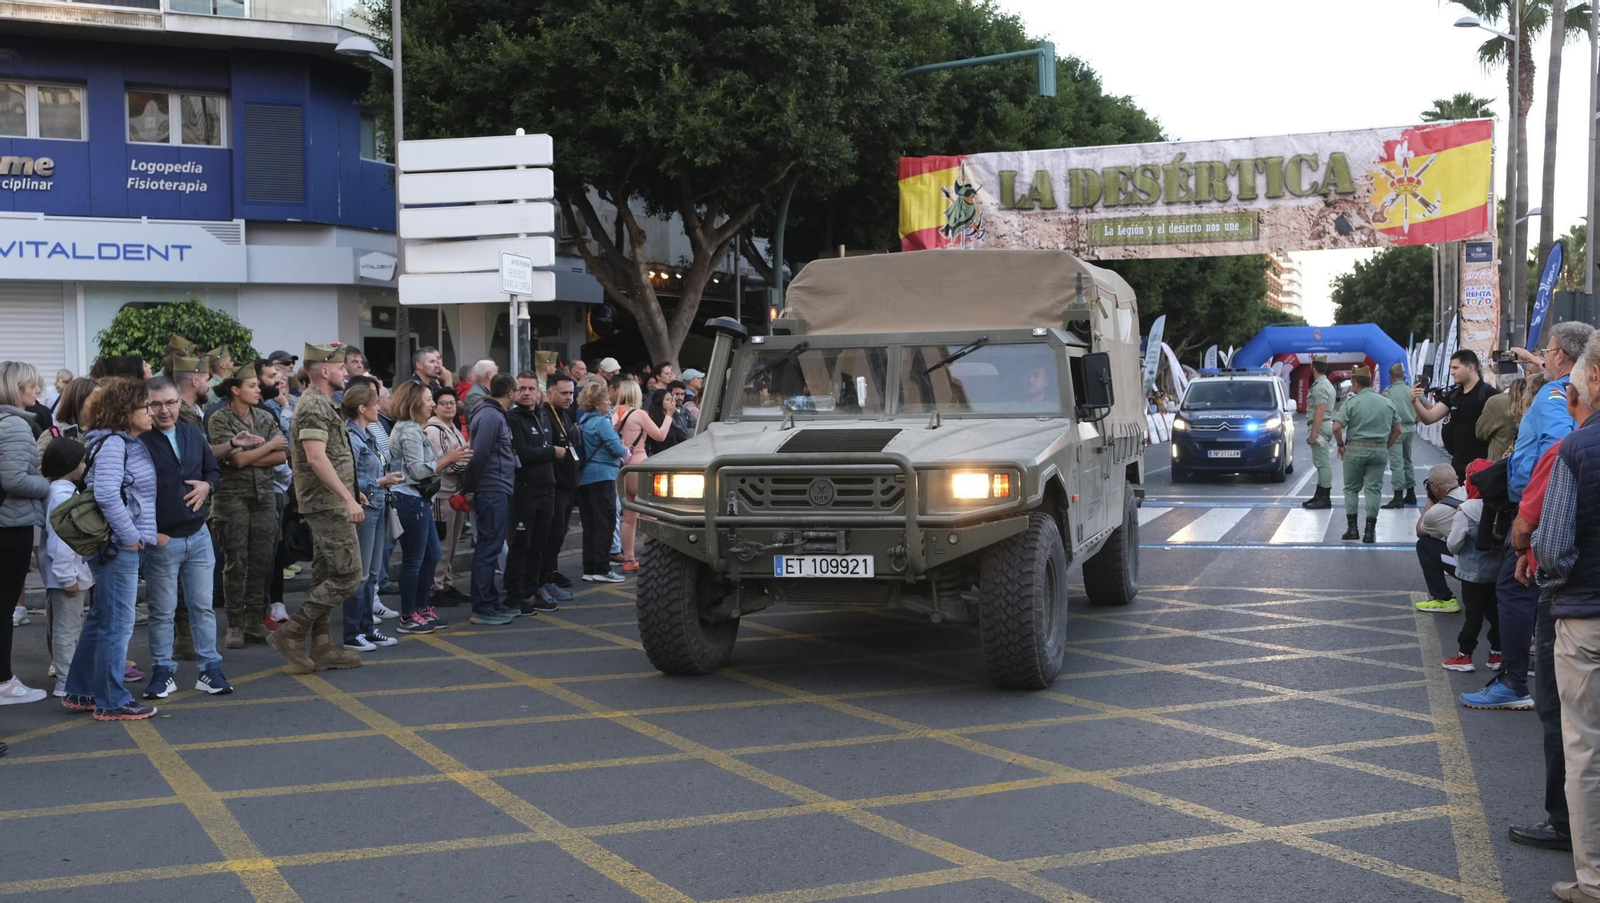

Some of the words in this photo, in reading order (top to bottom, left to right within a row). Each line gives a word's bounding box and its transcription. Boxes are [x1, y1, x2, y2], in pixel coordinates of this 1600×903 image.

[130, 159, 203, 175] Logopedia
[2, 178, 53, 192] ciplinar
[127, 177, 208, 194] Fisioterapia
[998, 169, 1057, 210] LA
[1068, 151, 1356, 210] DESÉRTICA
[1104, 225, 1114, 236] La
[1117, 224, 1144, 237] Legión
[1148, 226, 1154, 236] y
[1157, 223, 1165, 234] el
[1168, 222, 1202, 234] desierto
[1206, 223, 1220, 232] nos
[1224, 222, 1240, 231] une
[0, 240, 192, 262] VITALDENT
[508, 268, 526, 280] FEDERICO
[786, 558, 805, 574] ET
[812, 558, 868, 574] 109921
